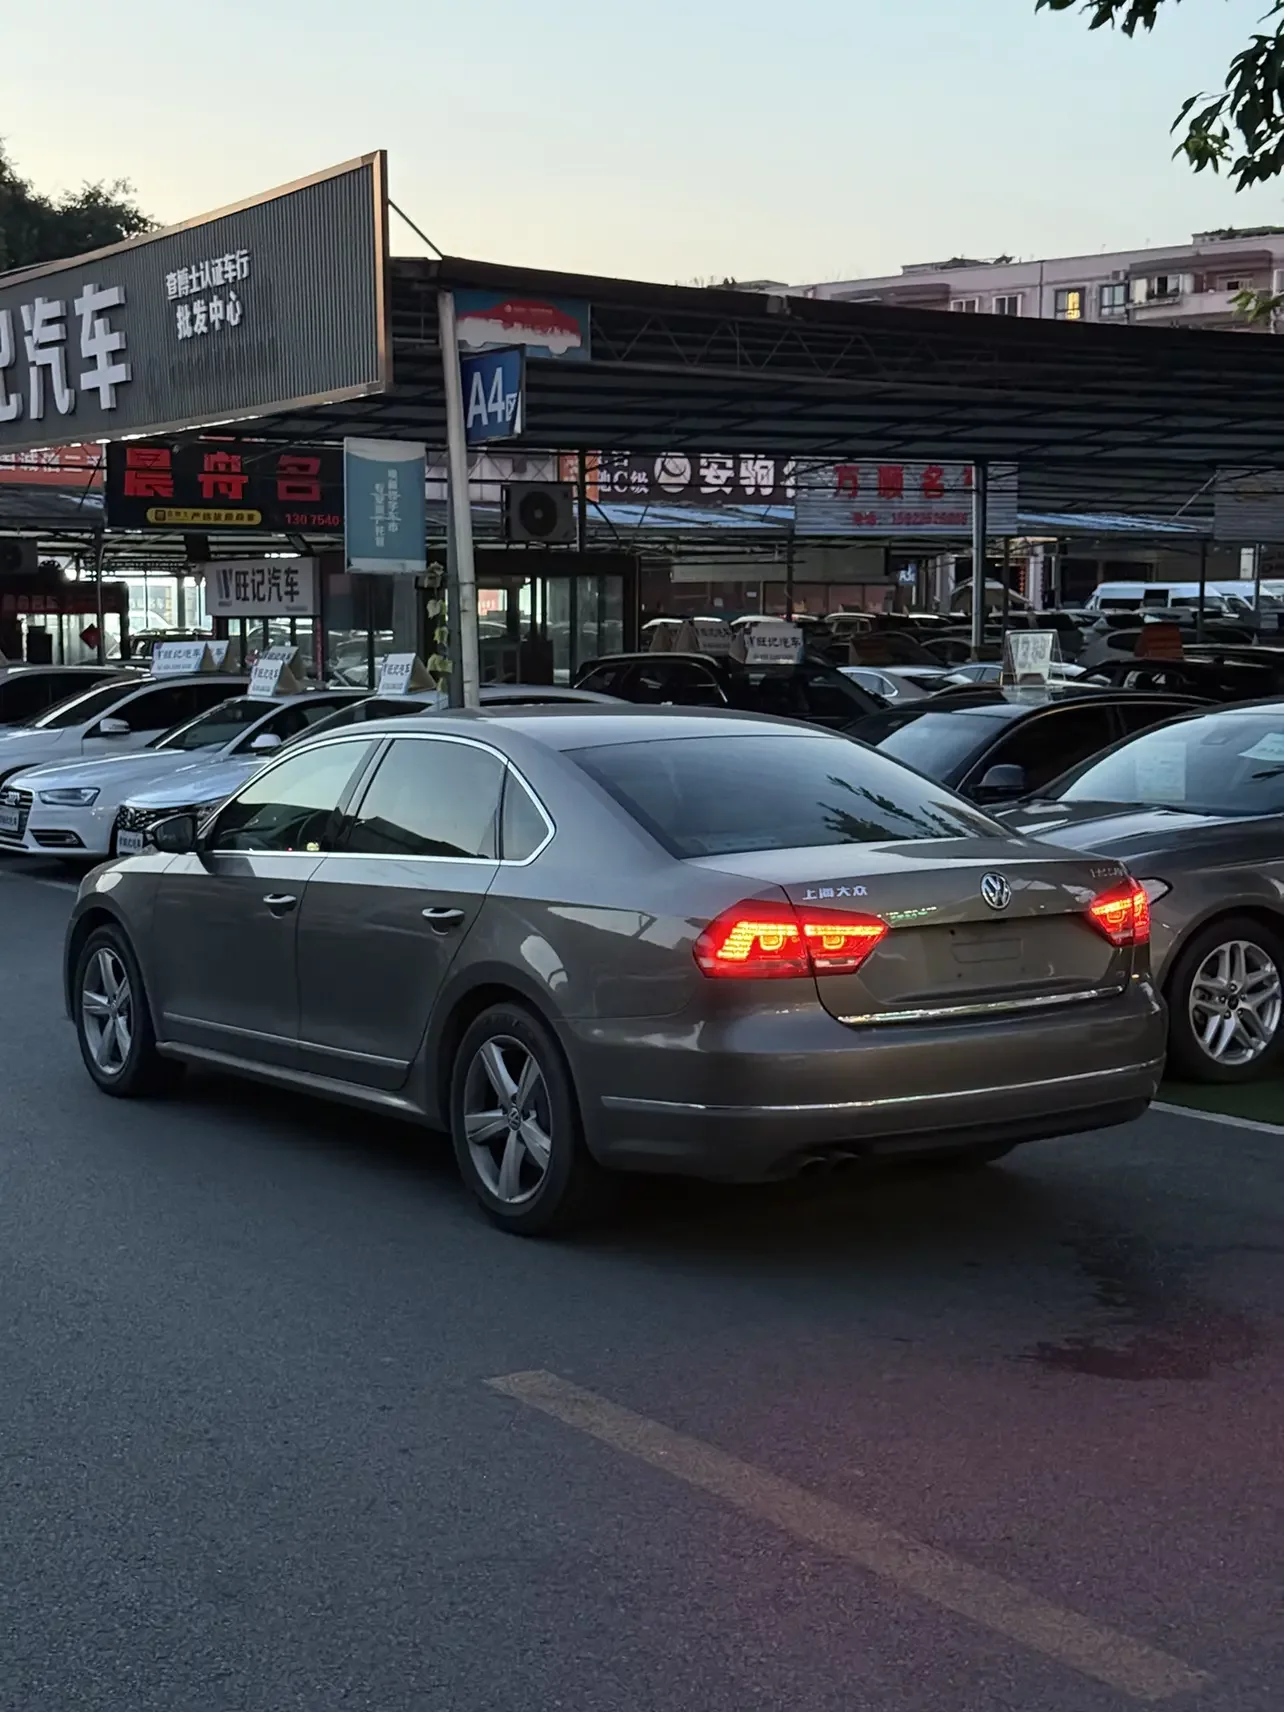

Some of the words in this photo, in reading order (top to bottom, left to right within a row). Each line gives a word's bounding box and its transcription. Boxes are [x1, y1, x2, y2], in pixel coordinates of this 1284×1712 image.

[176, 290, 242, 340] 批发中心
[467, 366, 517, 428] A4区
[234, 566, 300, 602] 旺记汽车
[802, 885, 869, 901] 上海大众
